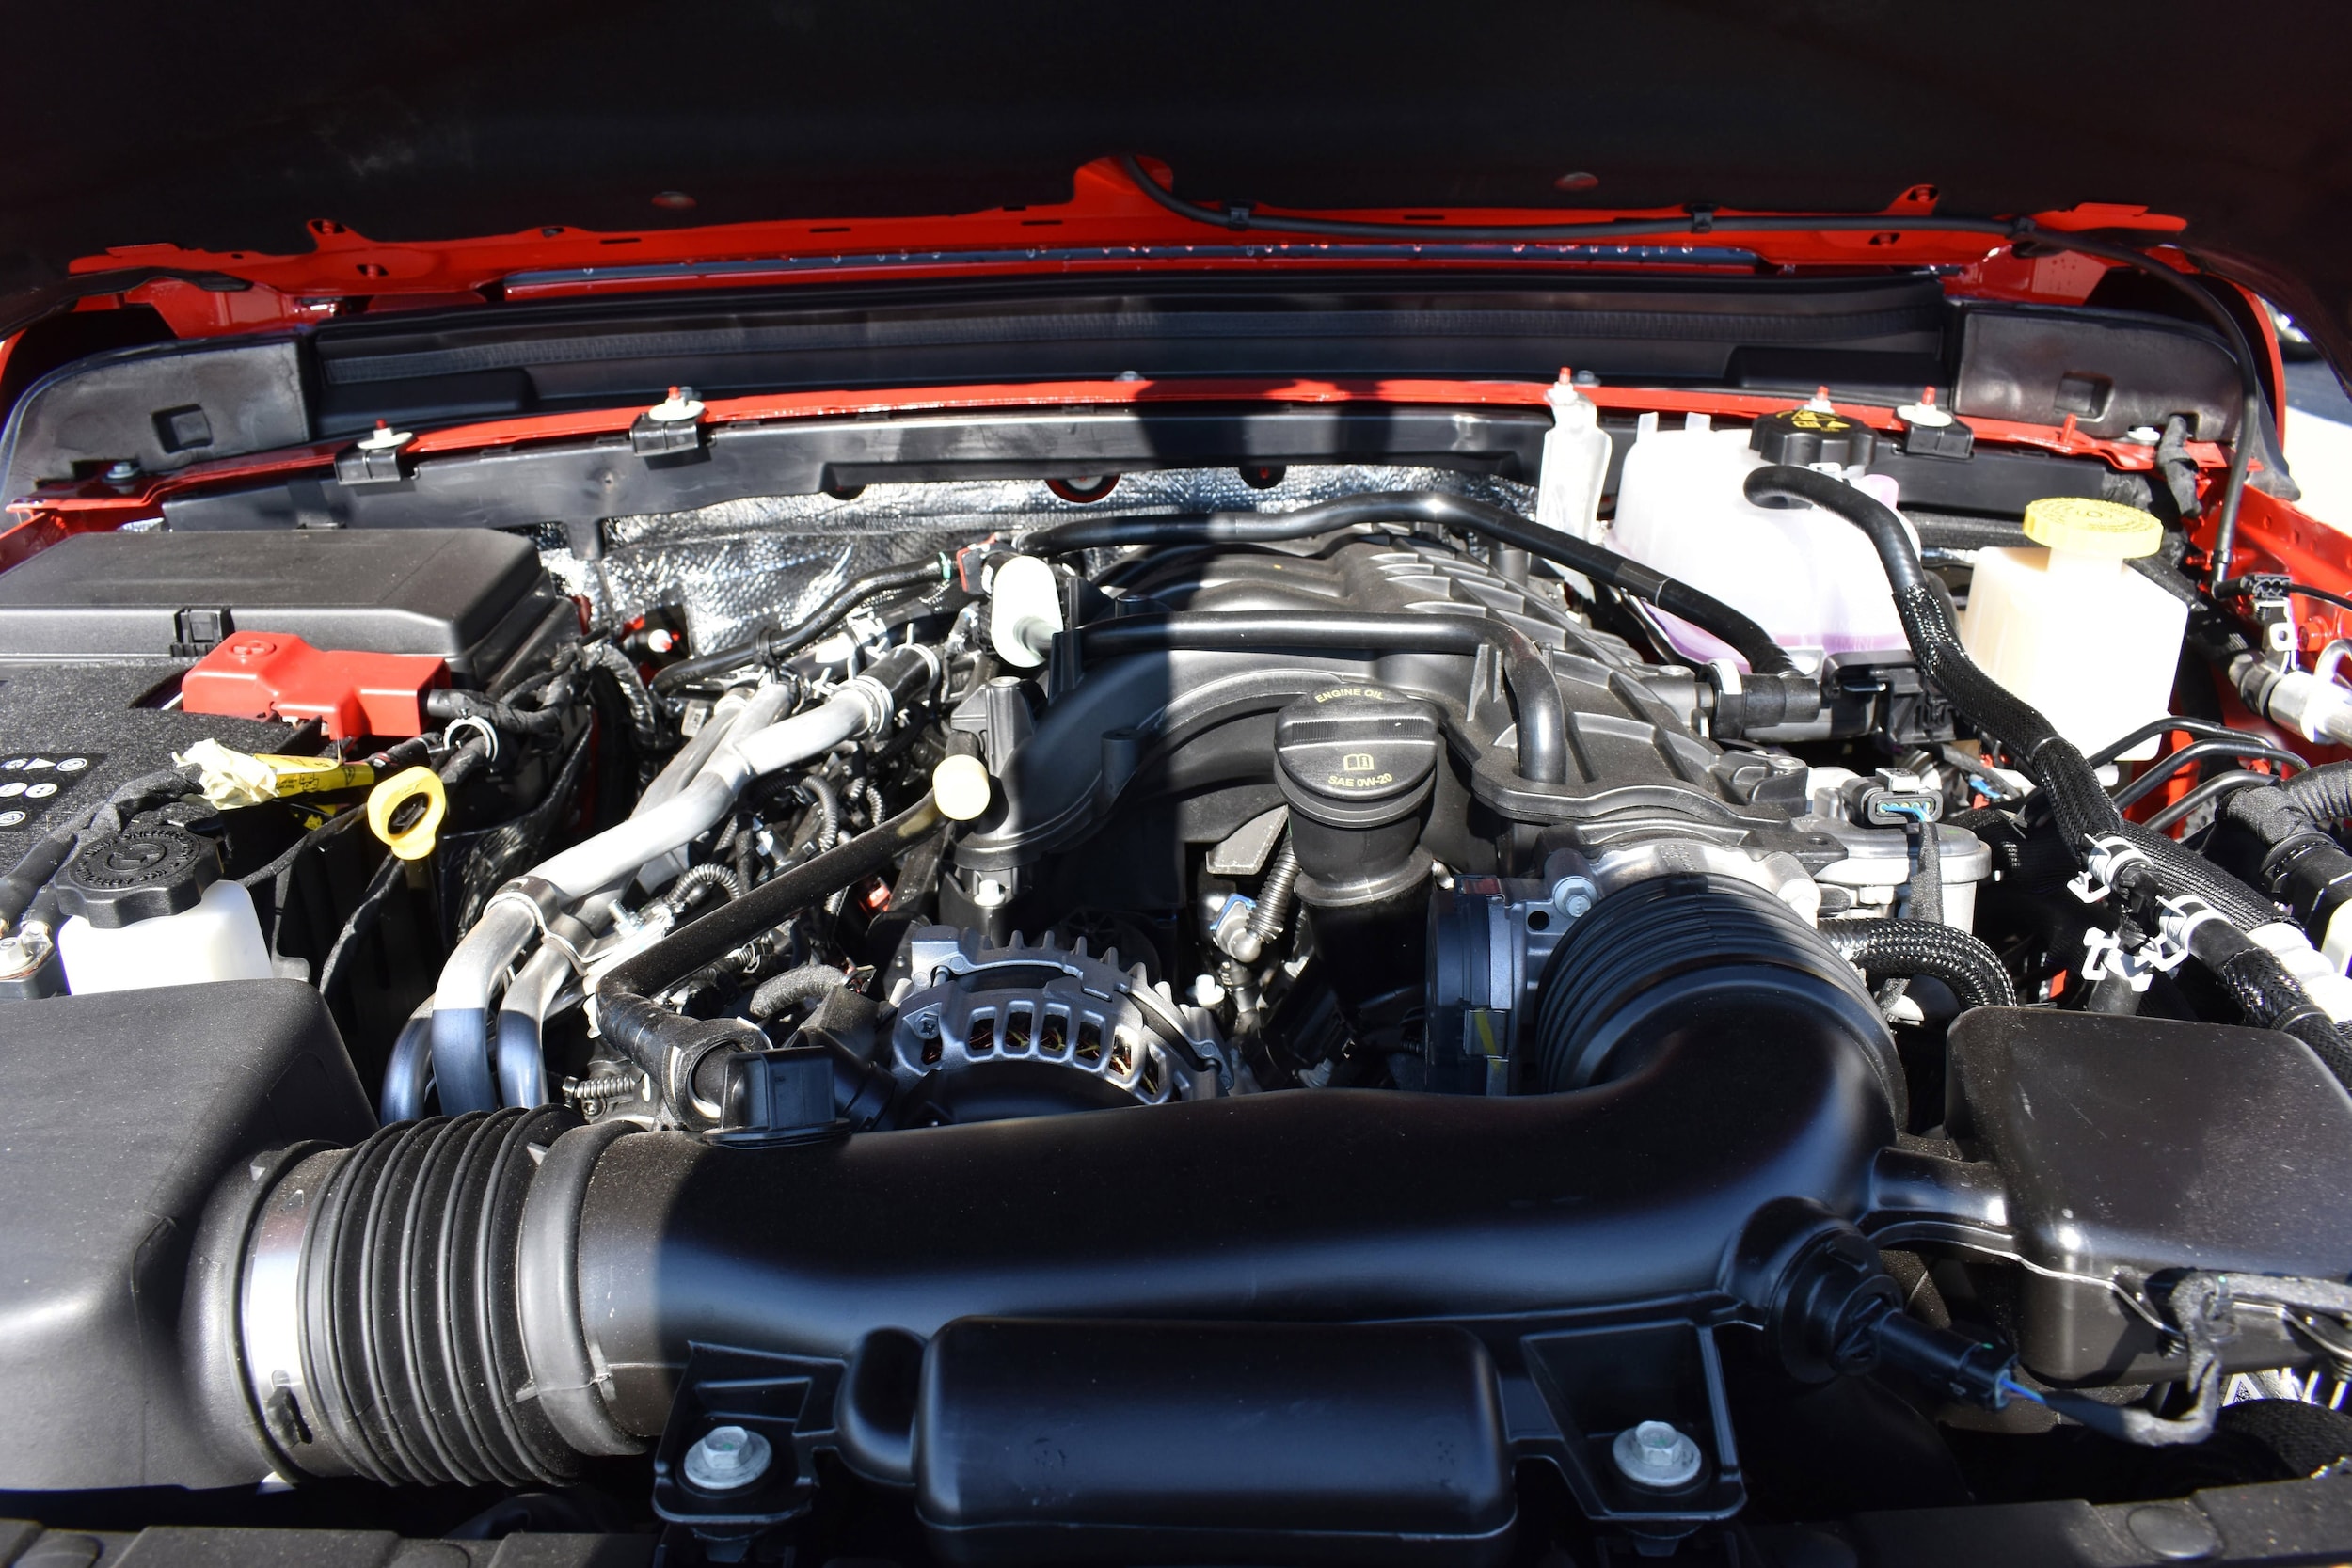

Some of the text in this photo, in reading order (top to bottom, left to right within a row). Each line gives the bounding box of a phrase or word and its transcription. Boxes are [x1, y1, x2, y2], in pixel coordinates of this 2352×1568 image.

[1314, 689, 1384, 703] ENGINE OIL
[1327, 772, 1393, 787] SAE 0W-20
